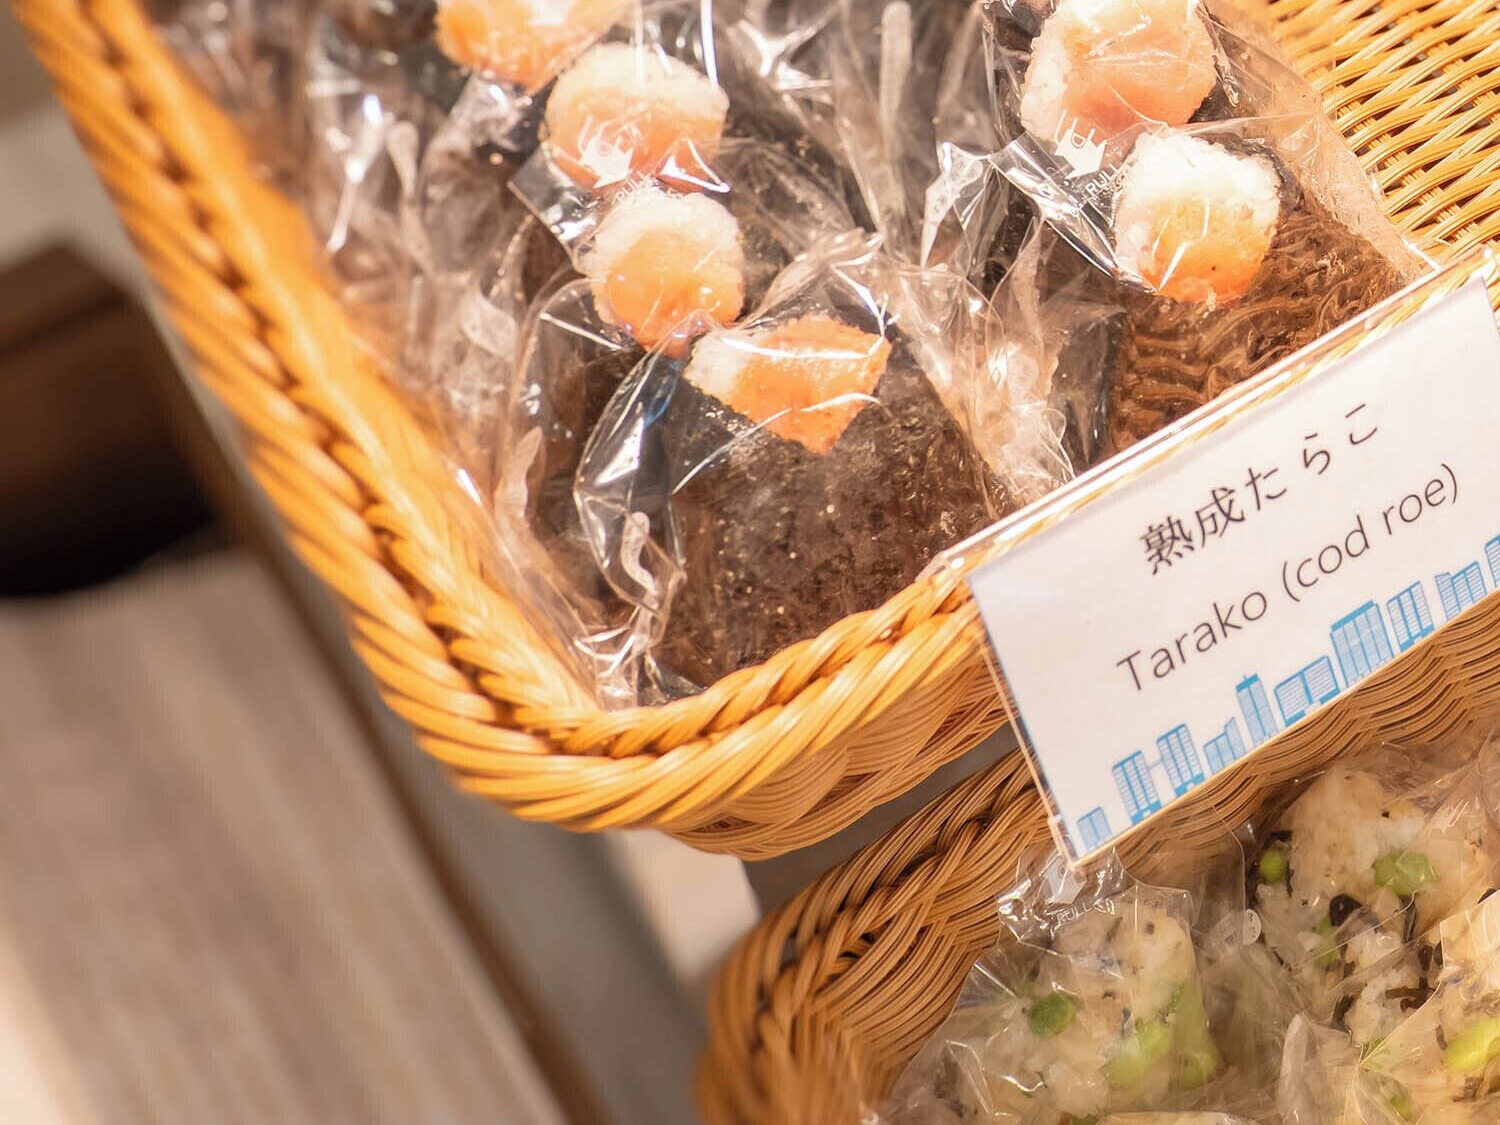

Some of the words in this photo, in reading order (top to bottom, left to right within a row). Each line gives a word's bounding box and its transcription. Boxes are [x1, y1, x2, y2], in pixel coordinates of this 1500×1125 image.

[1084, 163, 1122, 196] PULL
[1140, 401, 1380, 575] 熟成たらこ
[1116, 591, 1268, 691] Tarako
[1281, 515, 1371, 603] (cod
[1381, 462, 1461, 538] roe)
